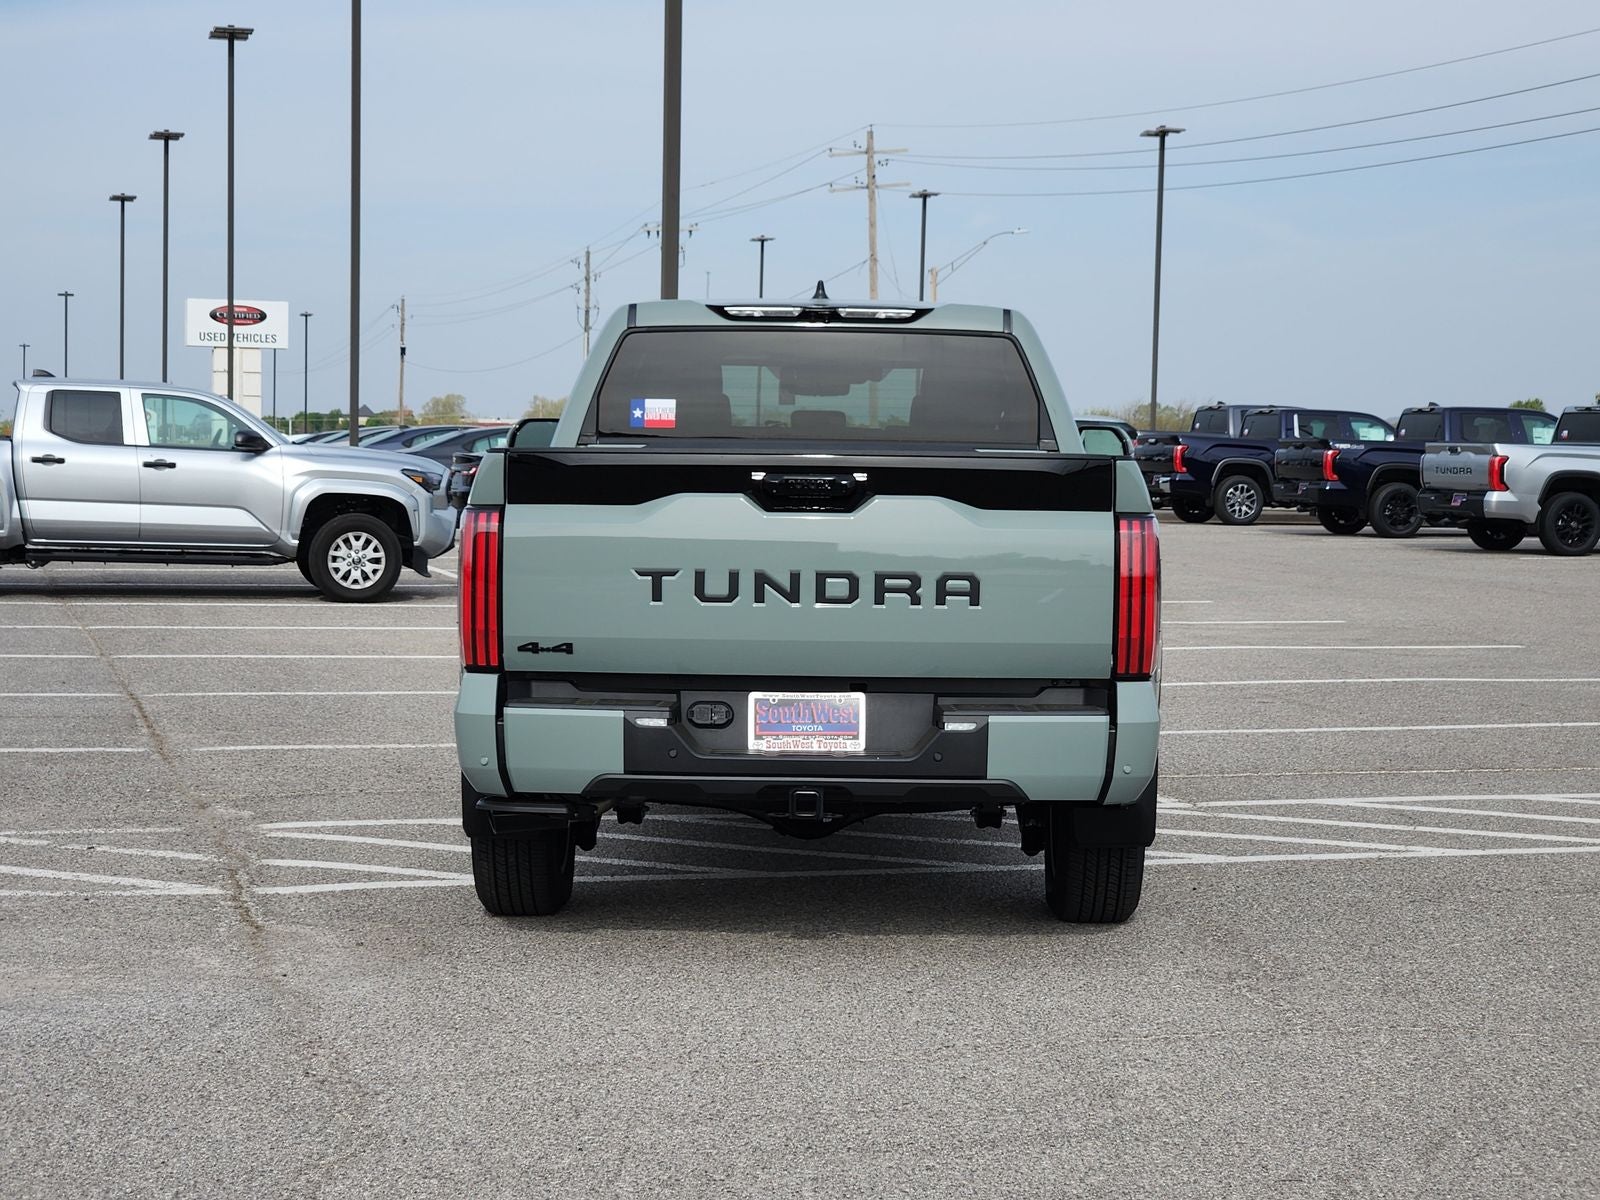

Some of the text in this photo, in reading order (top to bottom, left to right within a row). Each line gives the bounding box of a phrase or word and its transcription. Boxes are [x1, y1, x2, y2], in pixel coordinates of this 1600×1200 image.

[199, 332, 277, 343] USED EHICLES
[1434, 466, 1473, 475] TUNDRA
[630, 568, 982, 609] TUNDRA
[517, 642, 574, 655] 4x4
[765, 740, 848, 751] SouthWest Toyota
